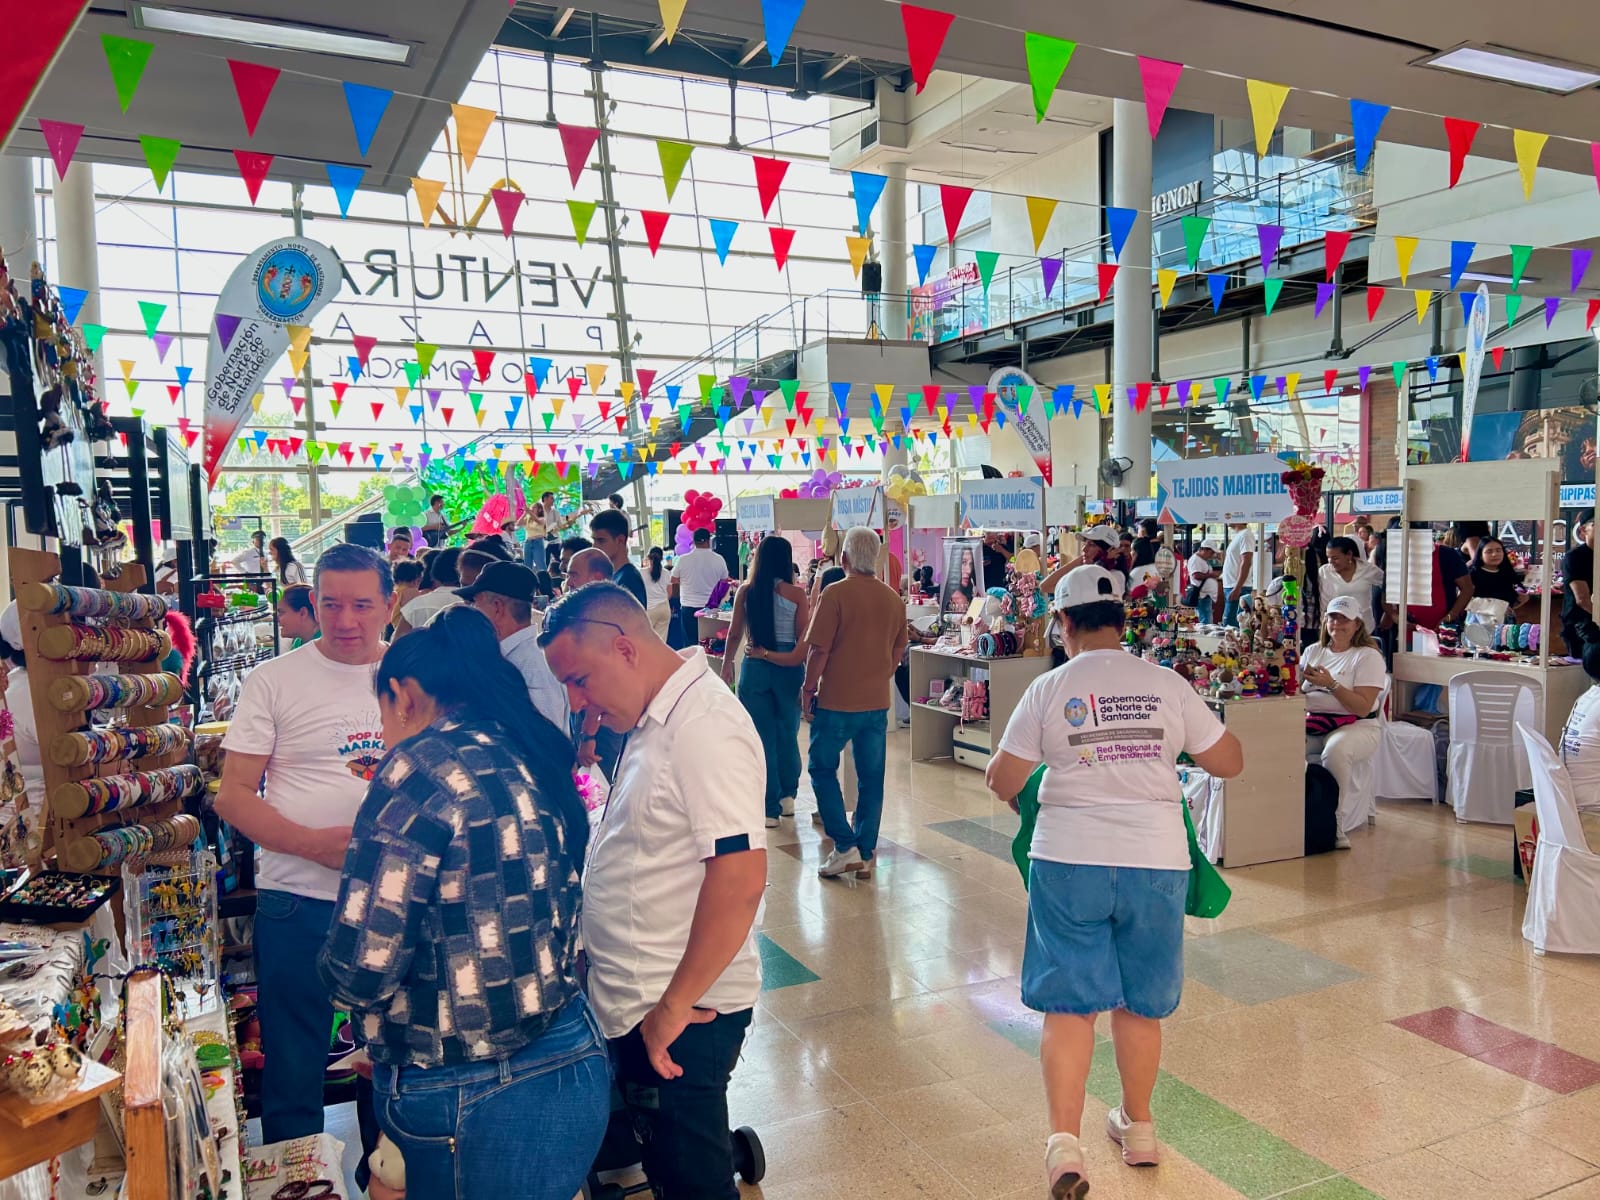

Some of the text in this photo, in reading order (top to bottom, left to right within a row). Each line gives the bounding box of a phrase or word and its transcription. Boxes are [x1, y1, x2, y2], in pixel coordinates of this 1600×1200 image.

[252, 244, 283, 282] DEPARTAMENTO
[287, 243, 309, 253] NORTE
[207, 322, 260, 400] Gobernación
[217, 336, 263, 408] de Norte de
[225, 351, 269, 414] Santander
[1172, 475, 1219, 498] TEJIDOS
[970, 489, 1035, 510] TATIANA RAMÍREZ
[1363, 495, 1383, 505] VELAS
[1098, 694, 1162, 705] Gobernación
[1100, 703, 1157, 713] de Norte de
[1101, 712, 1151, 722] Santander
[347, 731, 383, 743] POP U
[338, 740, 386, 755] MARK
[1096, 745, 1113, 754] Red
[1114, 744, 1151, 753] Regional
